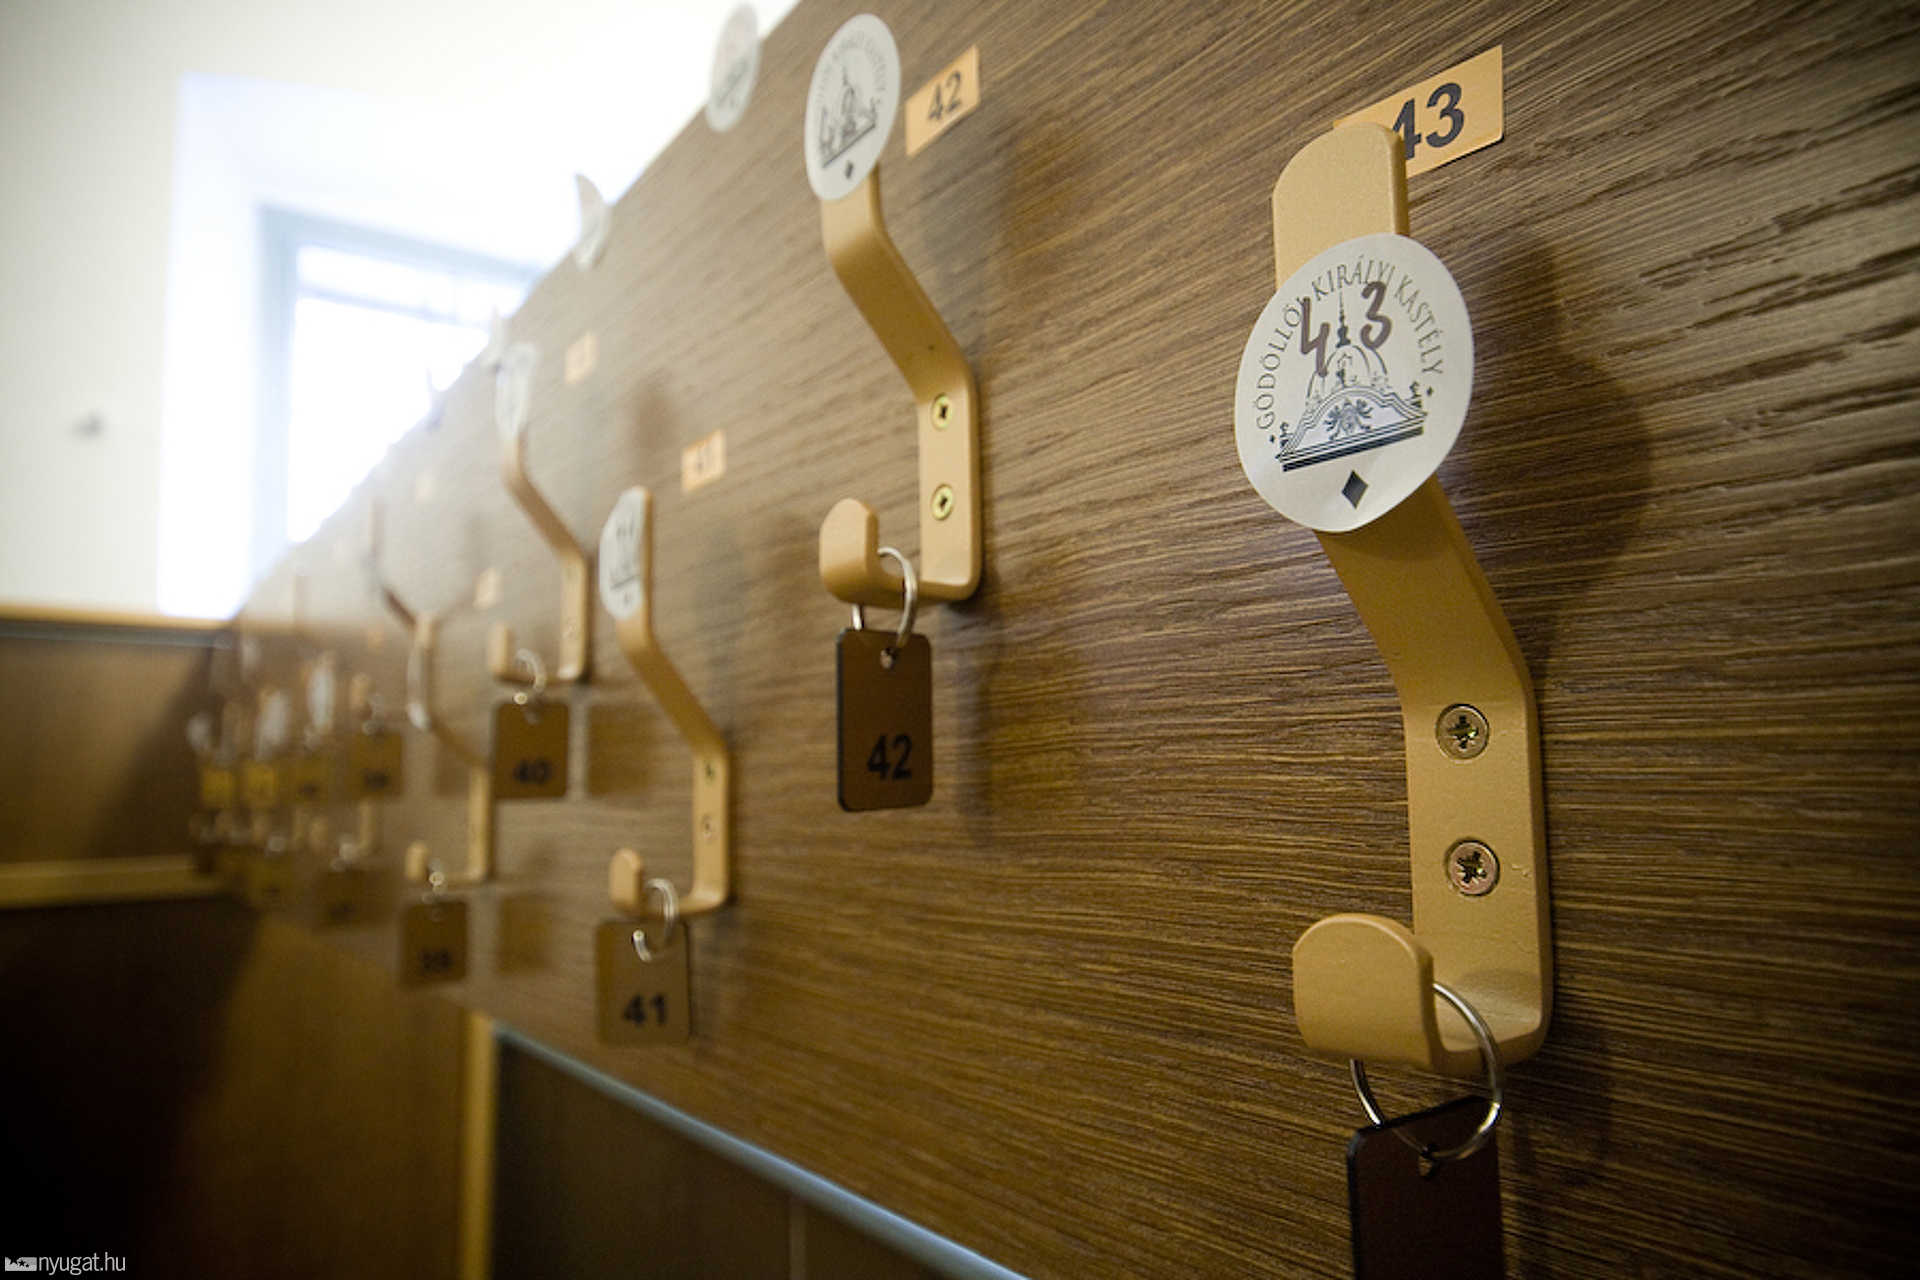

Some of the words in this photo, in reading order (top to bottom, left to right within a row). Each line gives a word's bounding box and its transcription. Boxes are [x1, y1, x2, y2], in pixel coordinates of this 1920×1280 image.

[928, 70, 962, 121] 42
[1392, 82, 1465, 160] 43
[1300, 281, 1392, 377] 43
[1311, 254, 1396, 301] KIRÁLYI
[1394, 274, 1444, 374] KASTÉLY
[866, 734, 913, 780] 42
[622, 994, 667, 1027] 41
